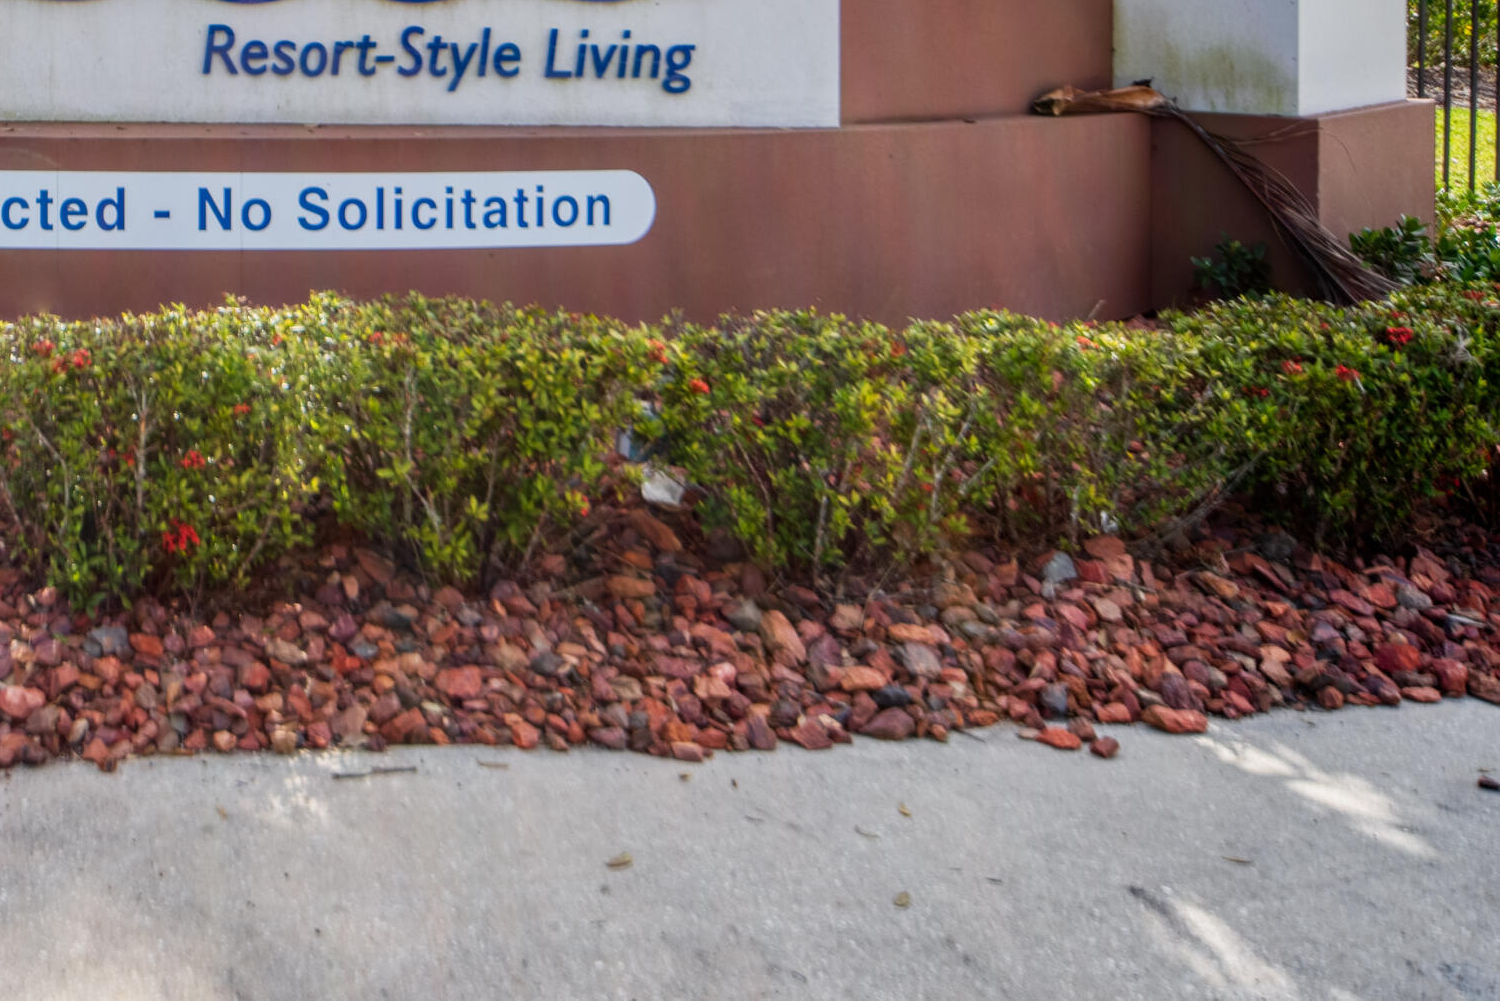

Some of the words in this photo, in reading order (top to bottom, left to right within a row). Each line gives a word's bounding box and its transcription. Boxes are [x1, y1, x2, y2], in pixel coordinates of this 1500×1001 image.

[201, 23, 522, 93] Resort-Style
[543, 27, 697, 95] Living
[198, 187, 272, 232] No
[297, 185, 611, 232] Solicitation
